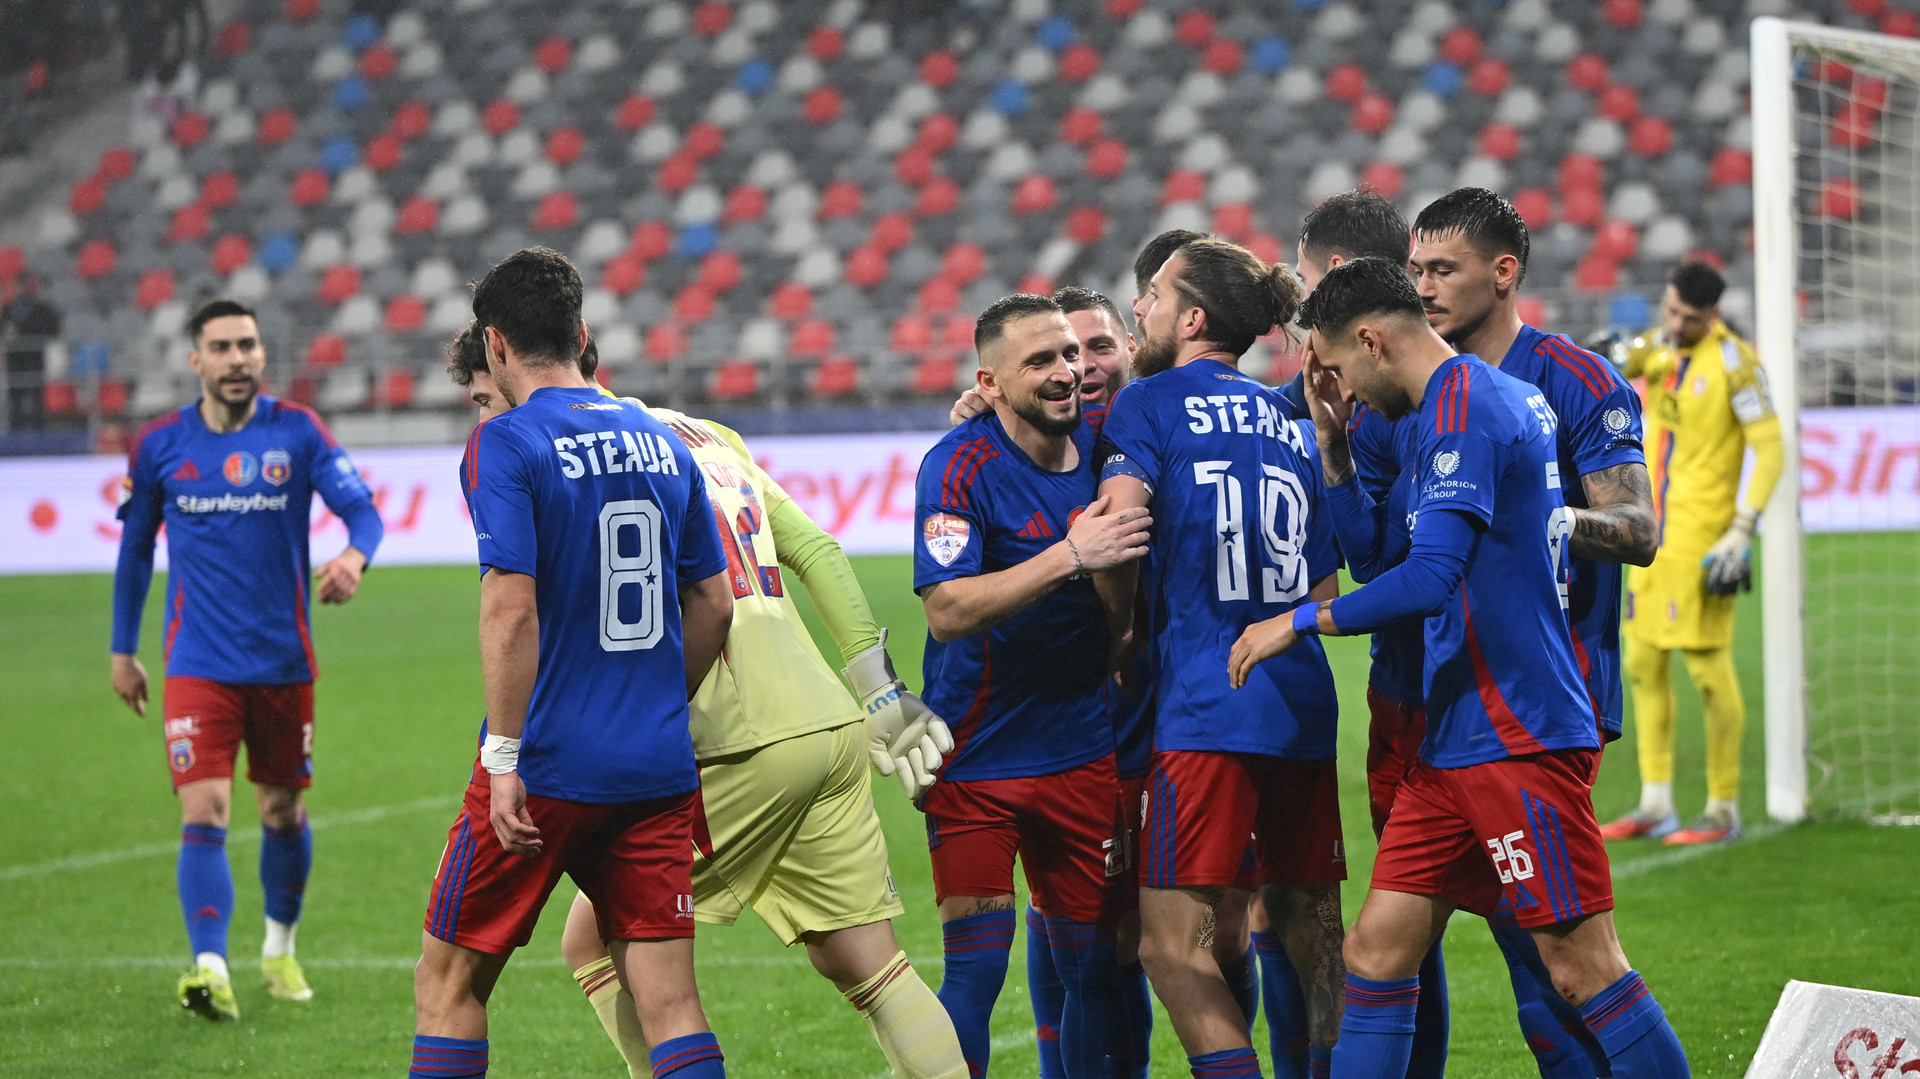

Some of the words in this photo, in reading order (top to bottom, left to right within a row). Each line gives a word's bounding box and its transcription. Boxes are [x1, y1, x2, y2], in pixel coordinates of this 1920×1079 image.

[554, 431, 679, 479] STEAUA
[176, 492, 290, 514] Stanleybet
[1428, 490, 1458, 500] GROUP
[1193, 461, 1309, 603] 19
[599, 499, 664, 652] 8
[1486, 829, 1535, 884] 26
